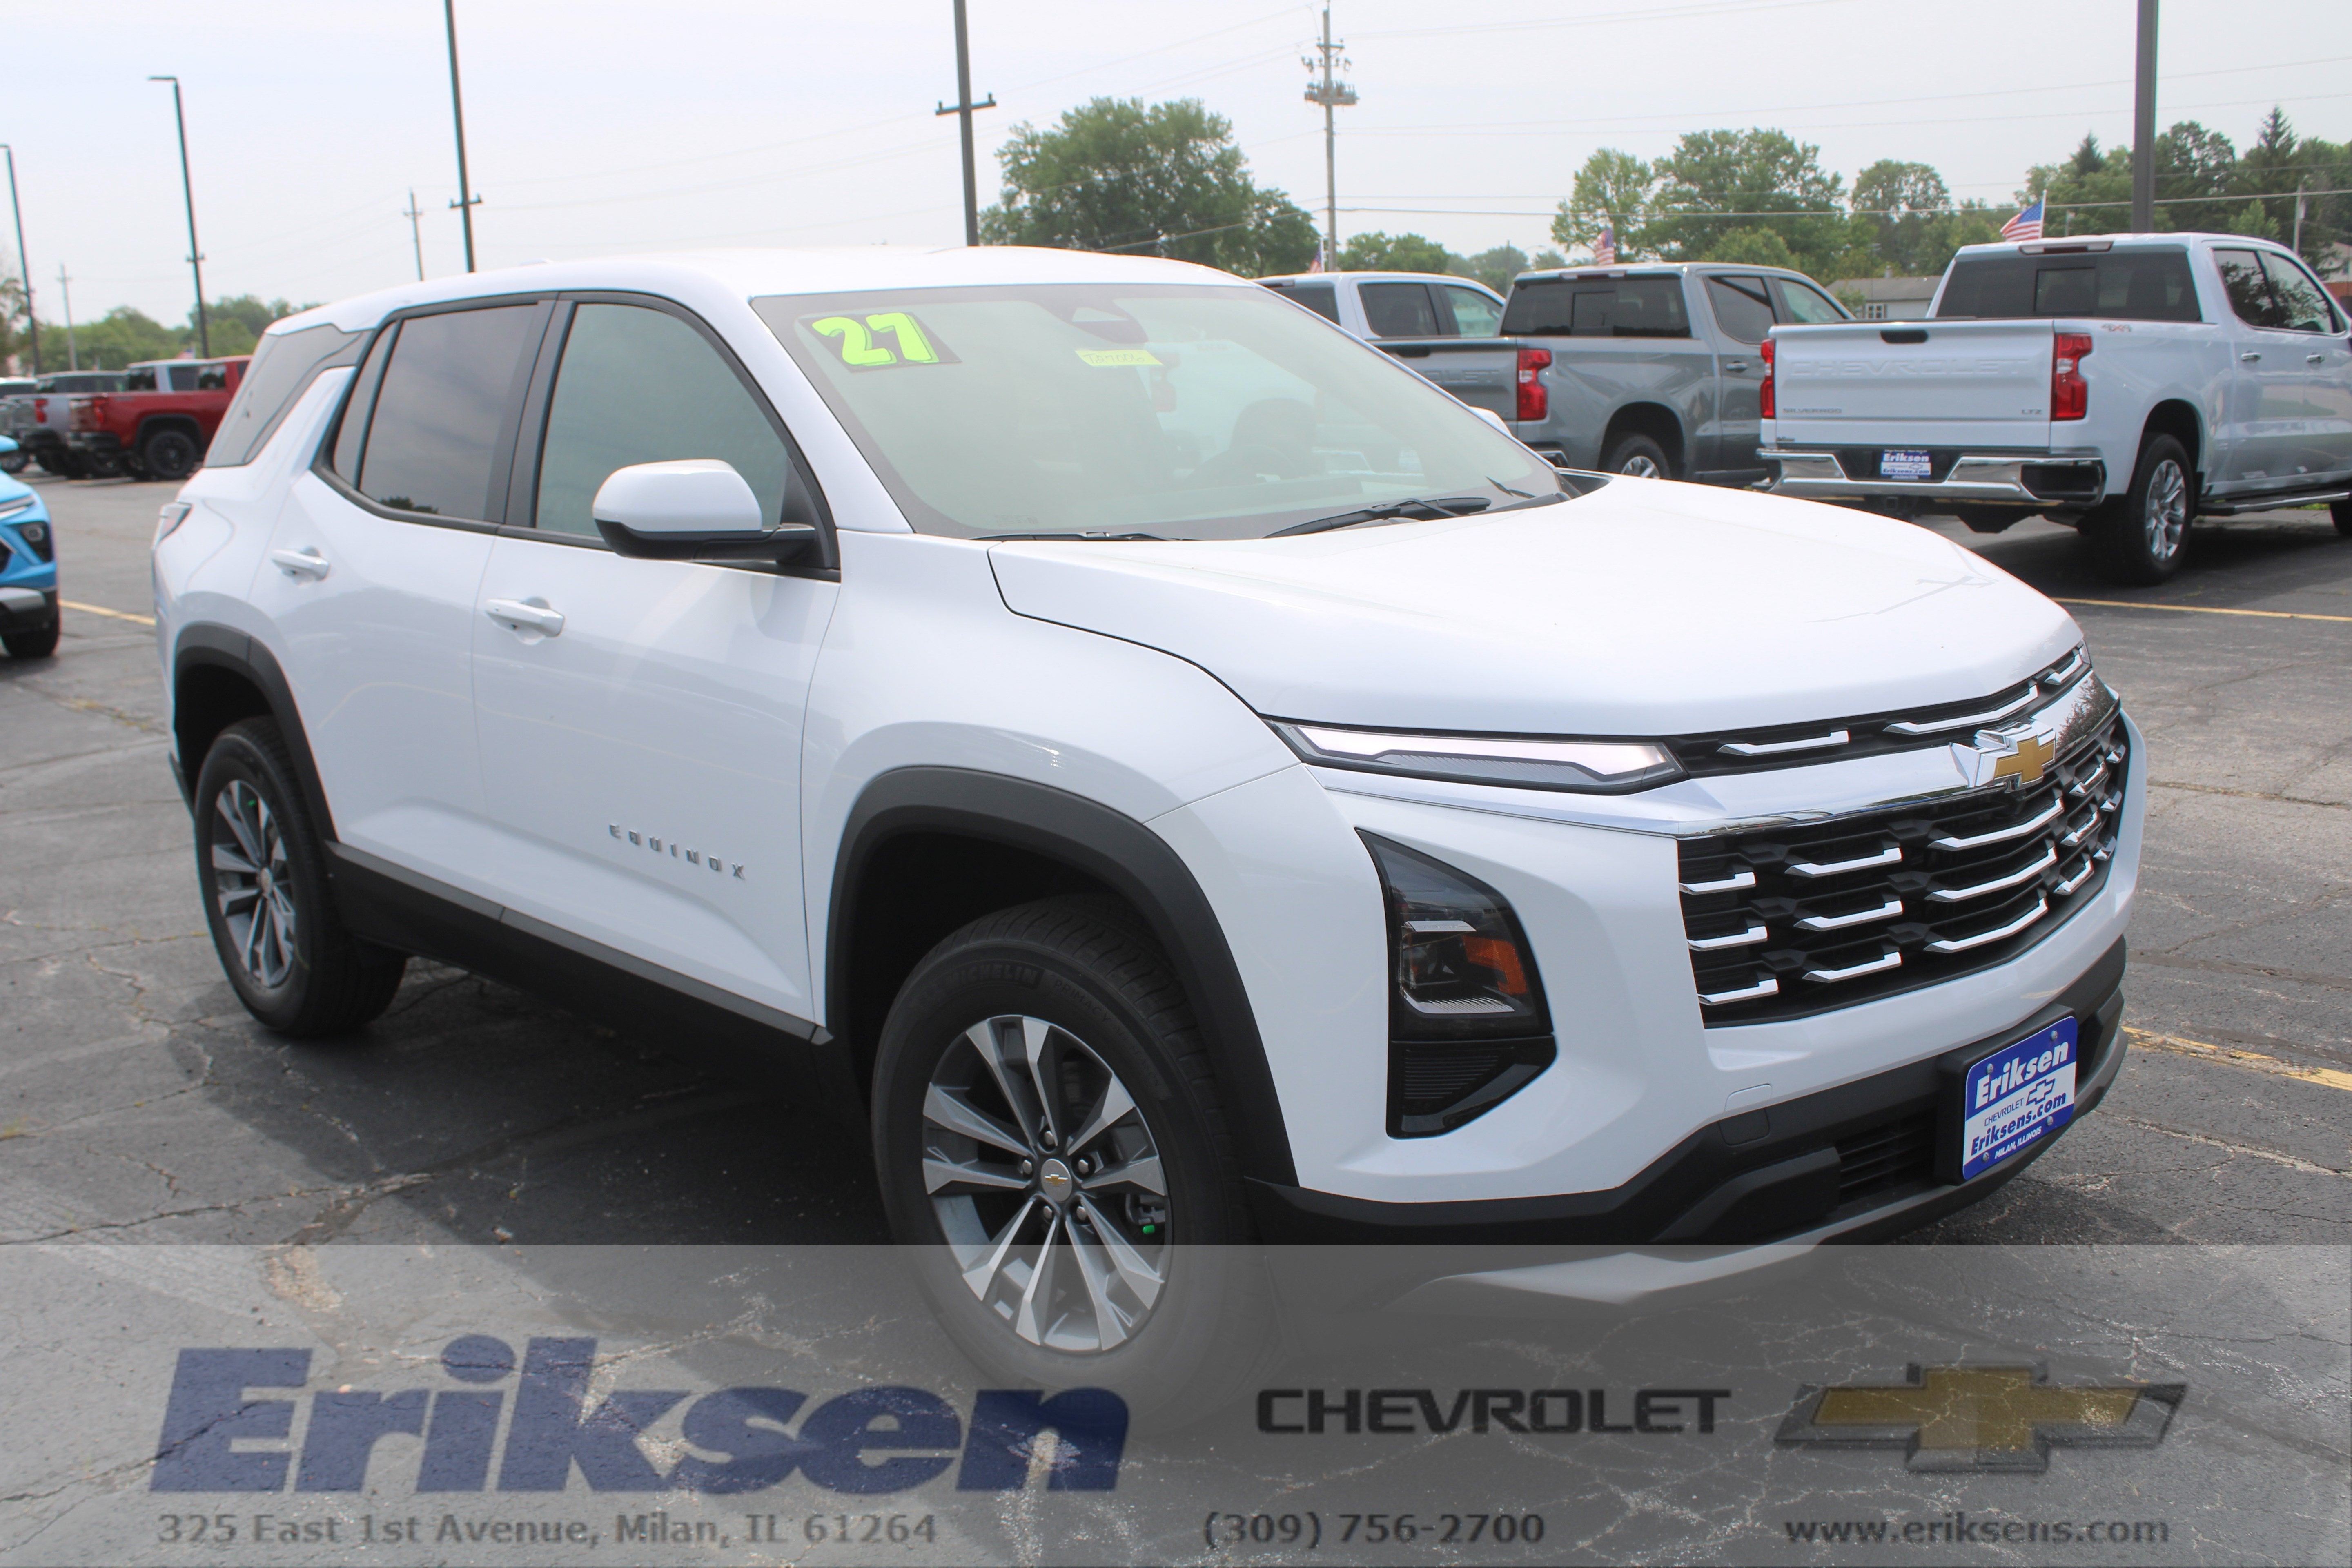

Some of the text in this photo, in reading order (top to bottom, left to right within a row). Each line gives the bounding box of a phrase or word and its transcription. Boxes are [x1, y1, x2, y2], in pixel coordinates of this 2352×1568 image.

[812, 312, 939, 366] 27
[1790, 359, 2029, 376] CHEVROLET
[1883, 453, 1929, 462] Eriksen
[609, 824, 746, 880] EQUINOX
[943, 964, 1038, 988] MICHELIN
[1054, 980, 1111, 1022] PRIMACY
[1975, 1042, 2069, 1109] Eriksen
[1971, 1093, 2066, 1156] Eriksens.com
[1984, 1098, 2024, 1126] CHEVROLET
[1995, 1126, 2042, 1159] MILAN, ILLINOIS
